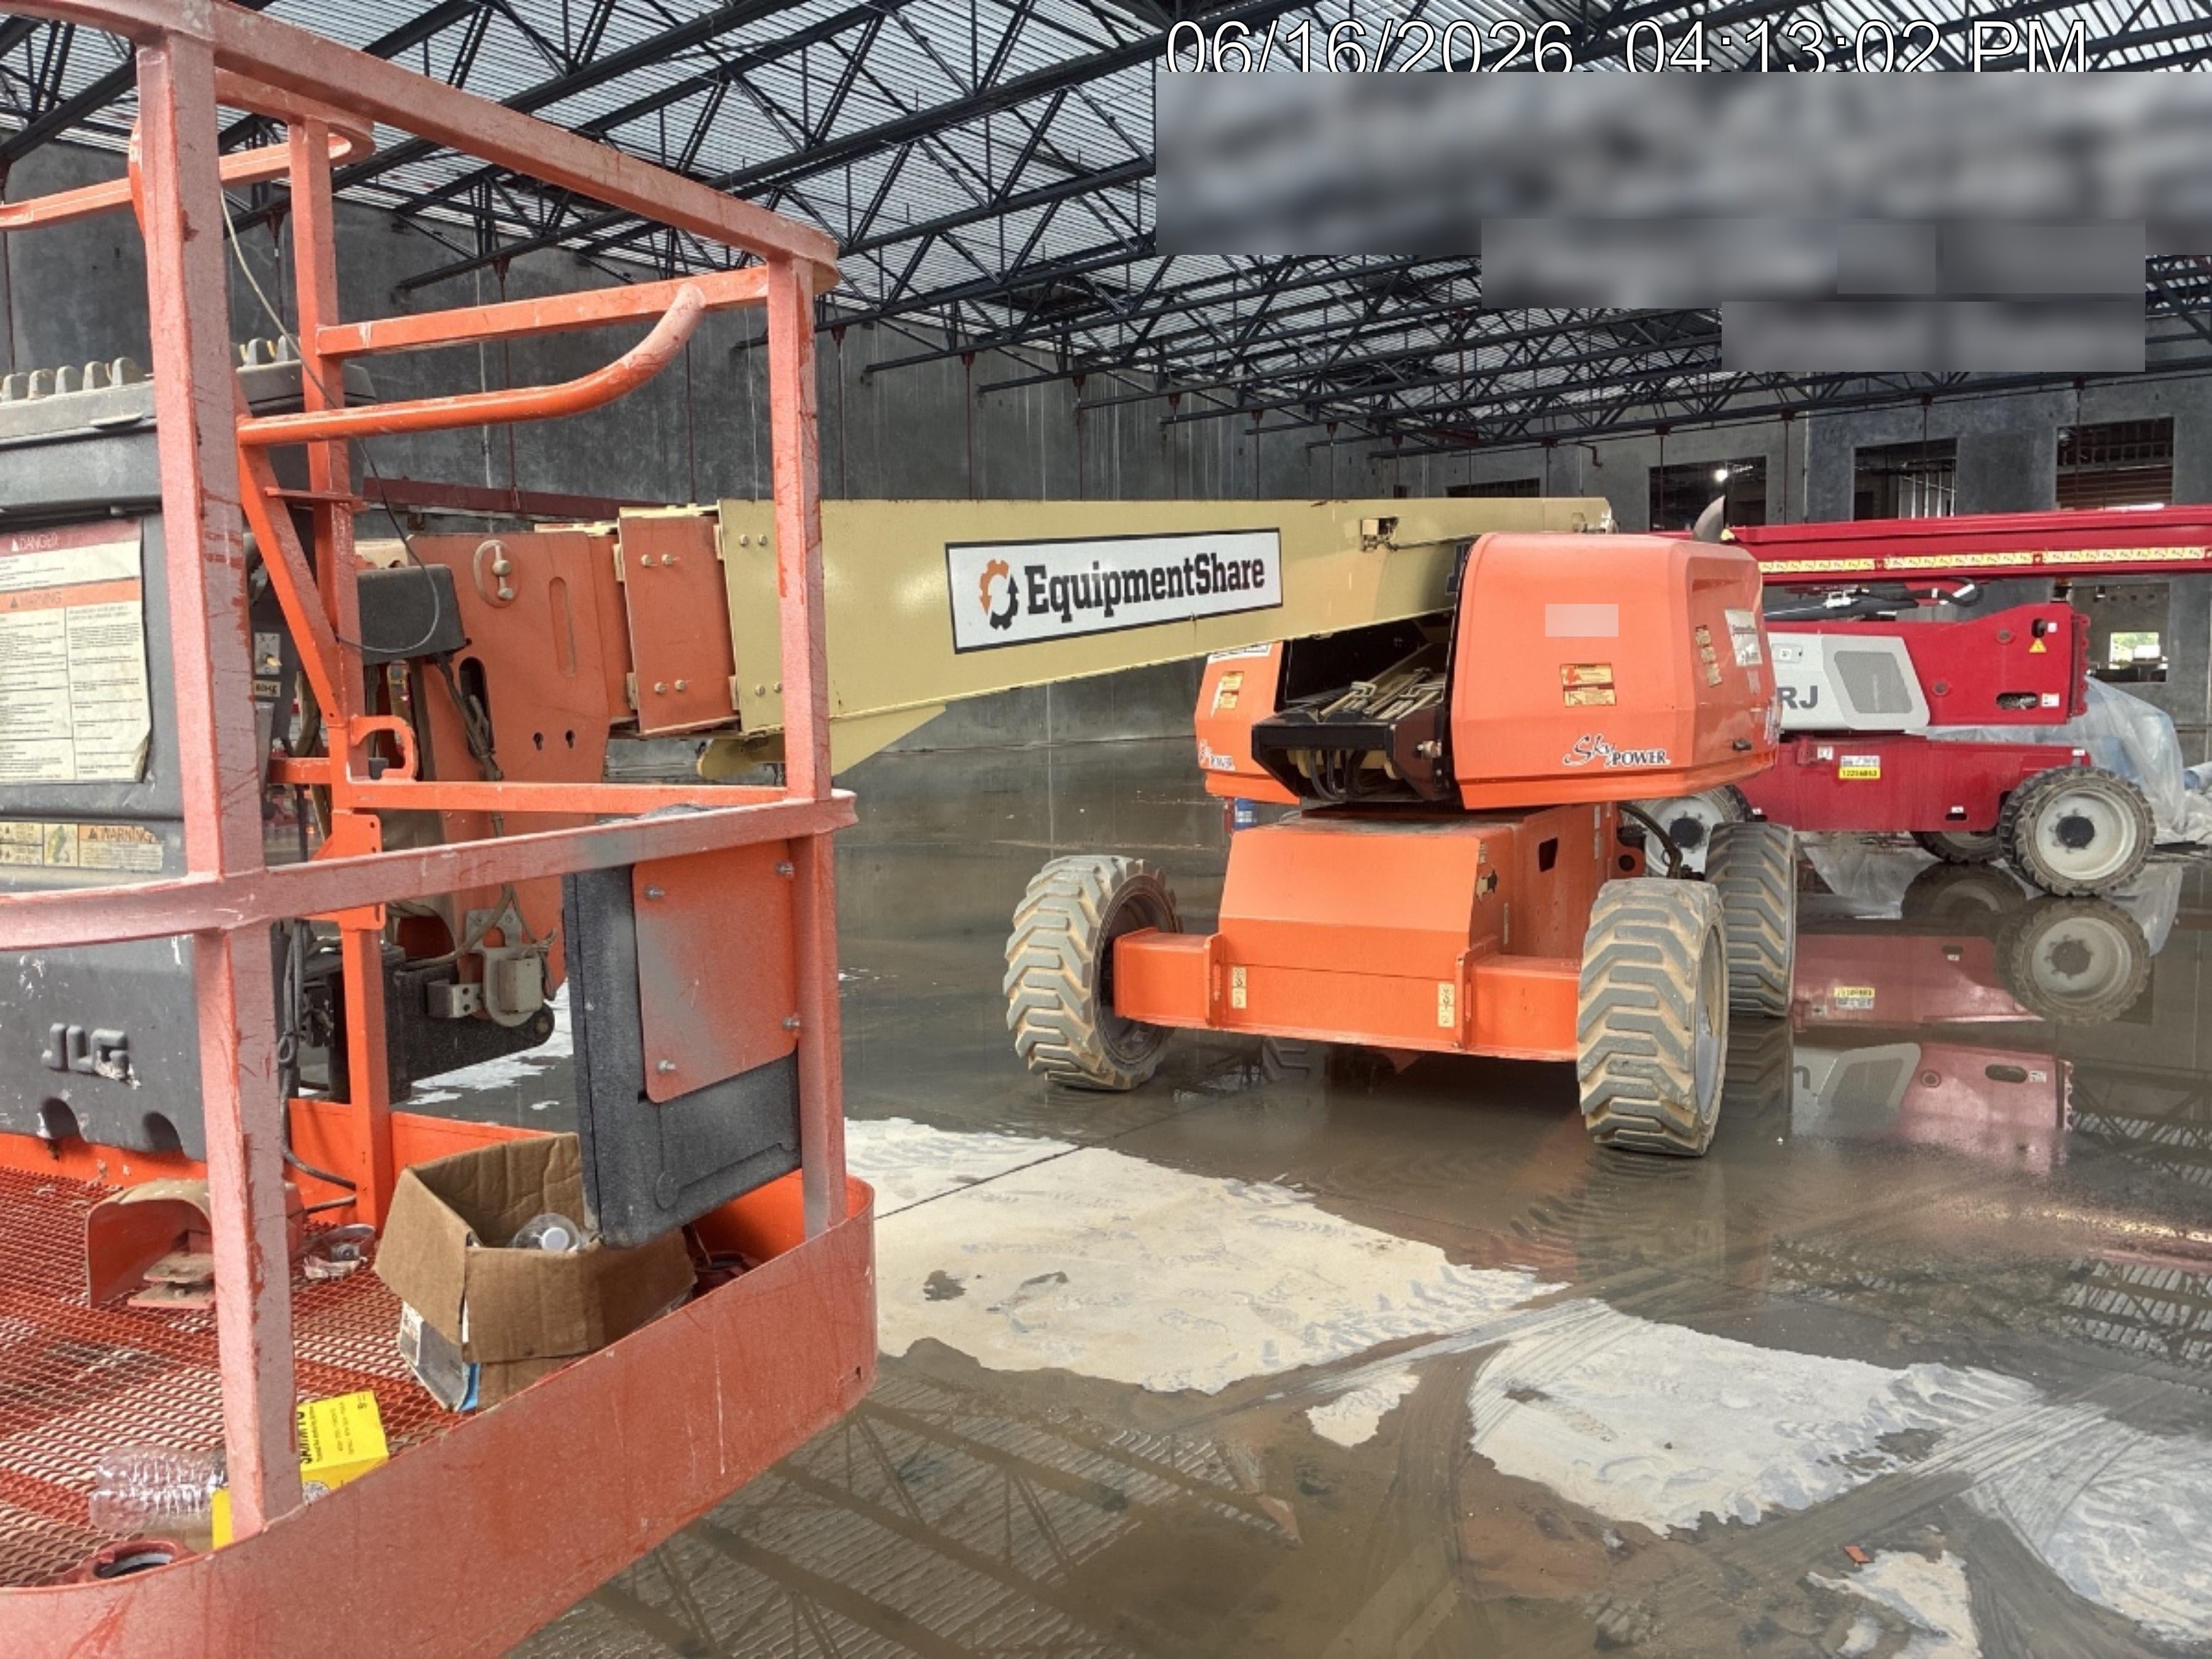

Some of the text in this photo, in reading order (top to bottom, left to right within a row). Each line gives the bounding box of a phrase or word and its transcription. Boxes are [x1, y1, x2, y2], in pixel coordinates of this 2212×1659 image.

[19, 532, 59, 551] DANGER
[1024, 552, 1265, 623] EquipmentShare
[1563, 734, 1667, 768] Sky POWER
[41, 1022, 129, 1080] JLG
